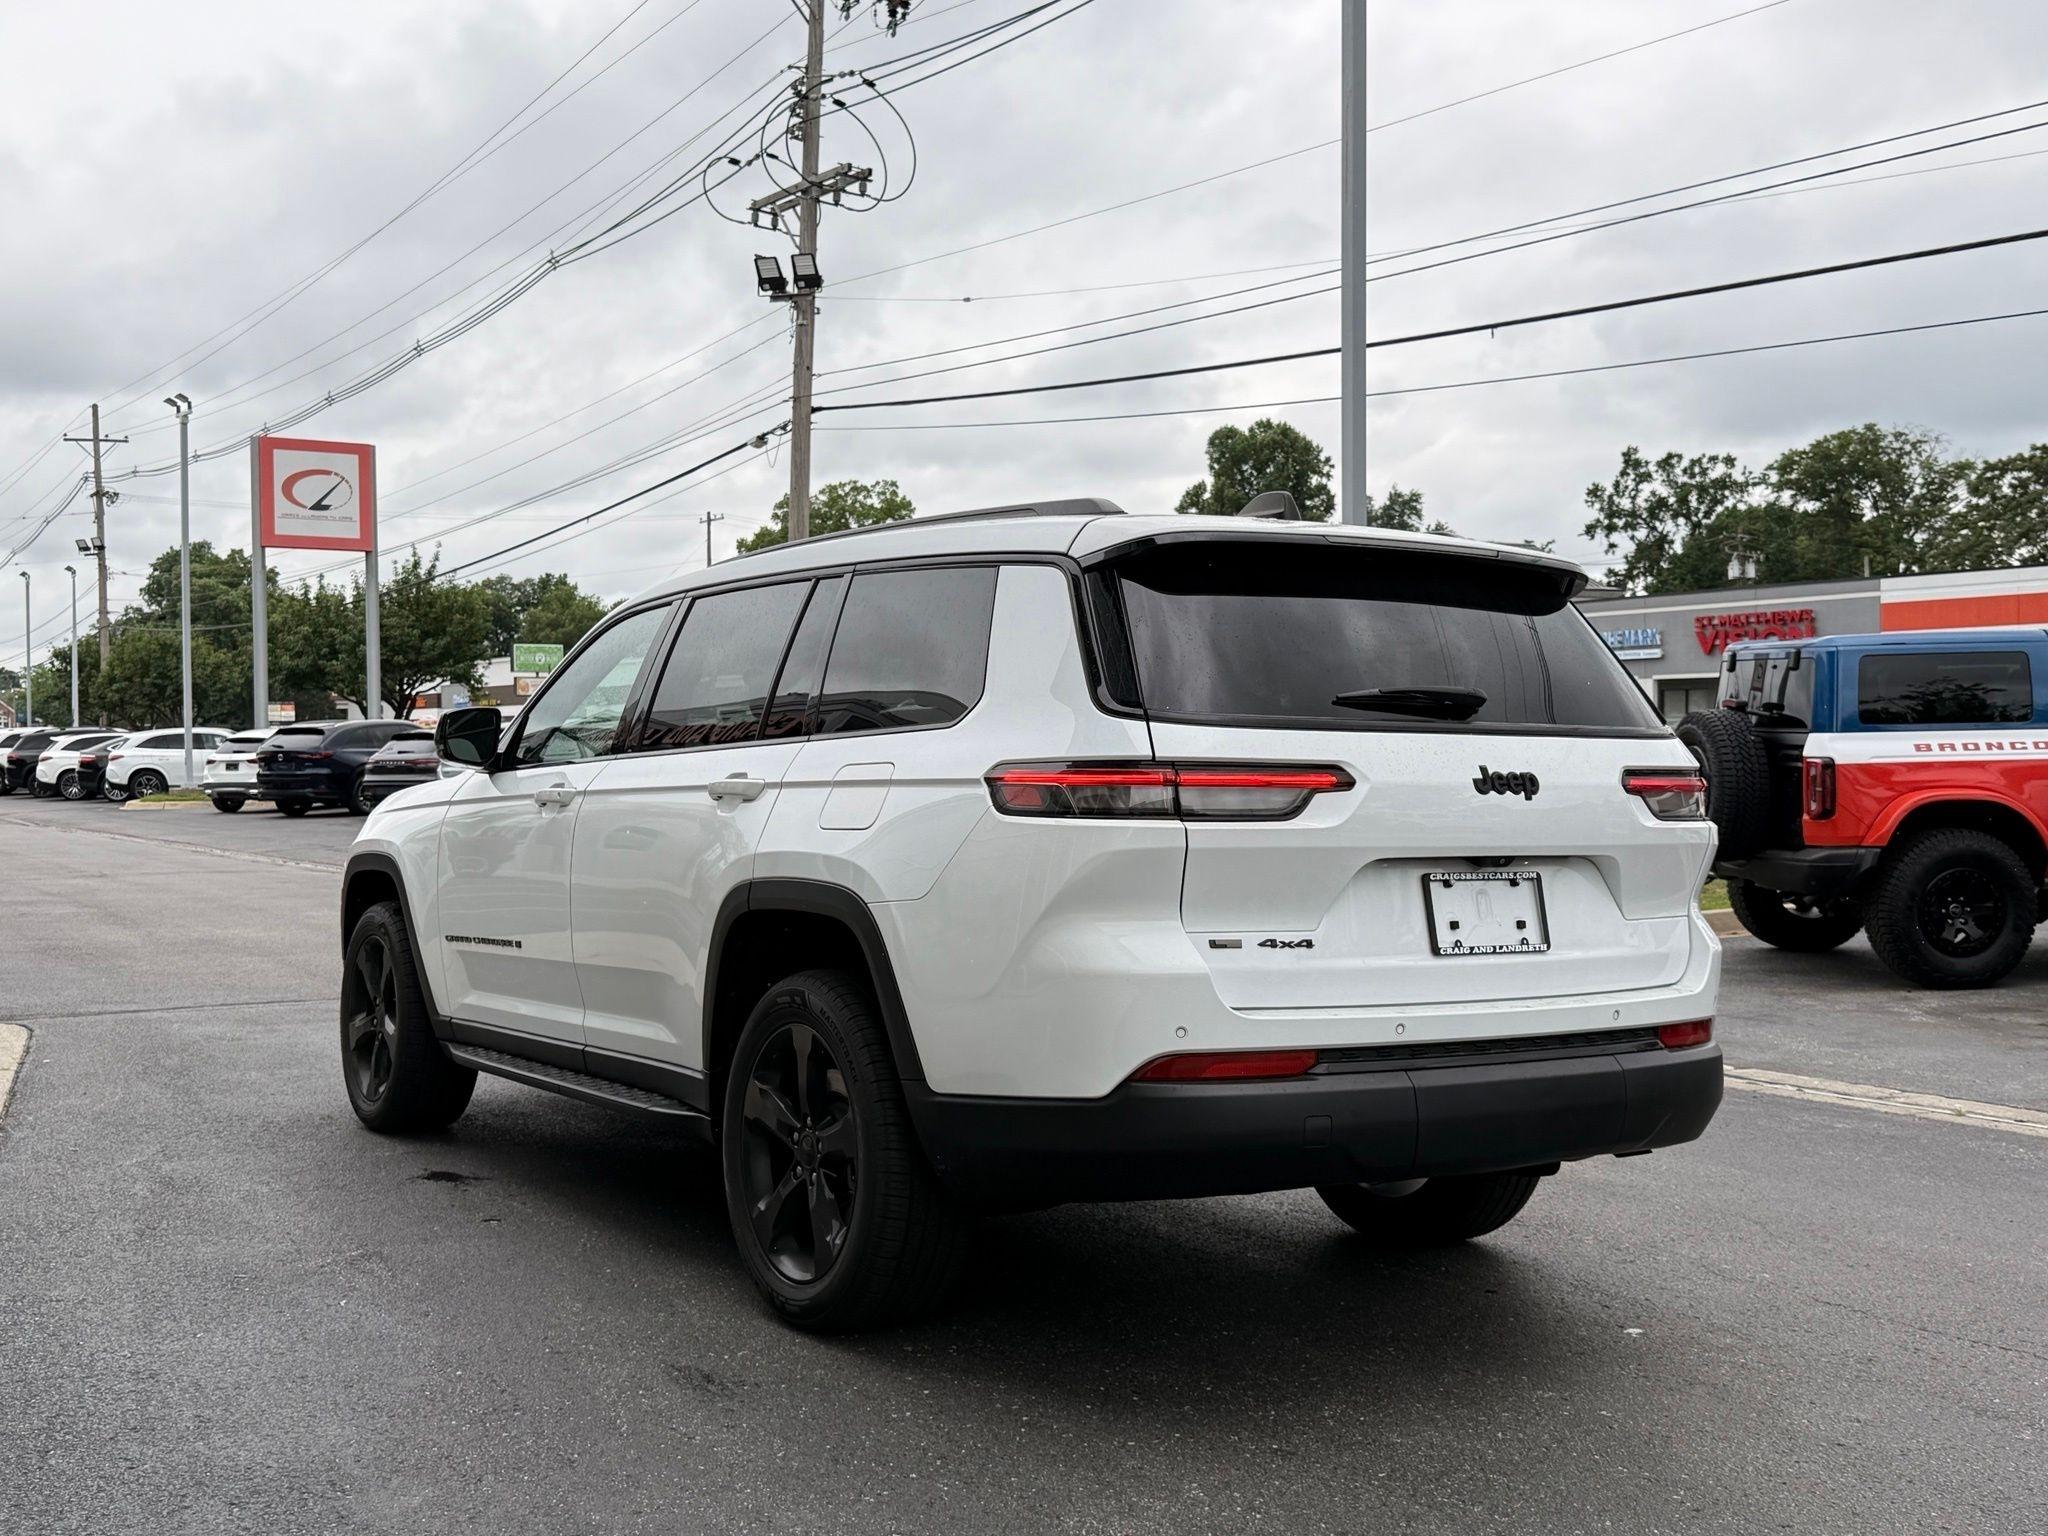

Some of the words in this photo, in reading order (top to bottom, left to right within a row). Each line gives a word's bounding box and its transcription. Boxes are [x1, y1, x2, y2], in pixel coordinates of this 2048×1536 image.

[1718, 609, 1814, 627] MATTHEWS
[1913, 741, 2048, 752] BRONCO
[1472, 764, 1540, 801] Jeep
[1430, 871, 1538, 880] CRAIGSBESTCARS.COM
[1440, 946, 1471, 955] CRAIG
[1472, 945, 1494, 954] AND
[1495, 943, 1548, 953] LANDRETH
